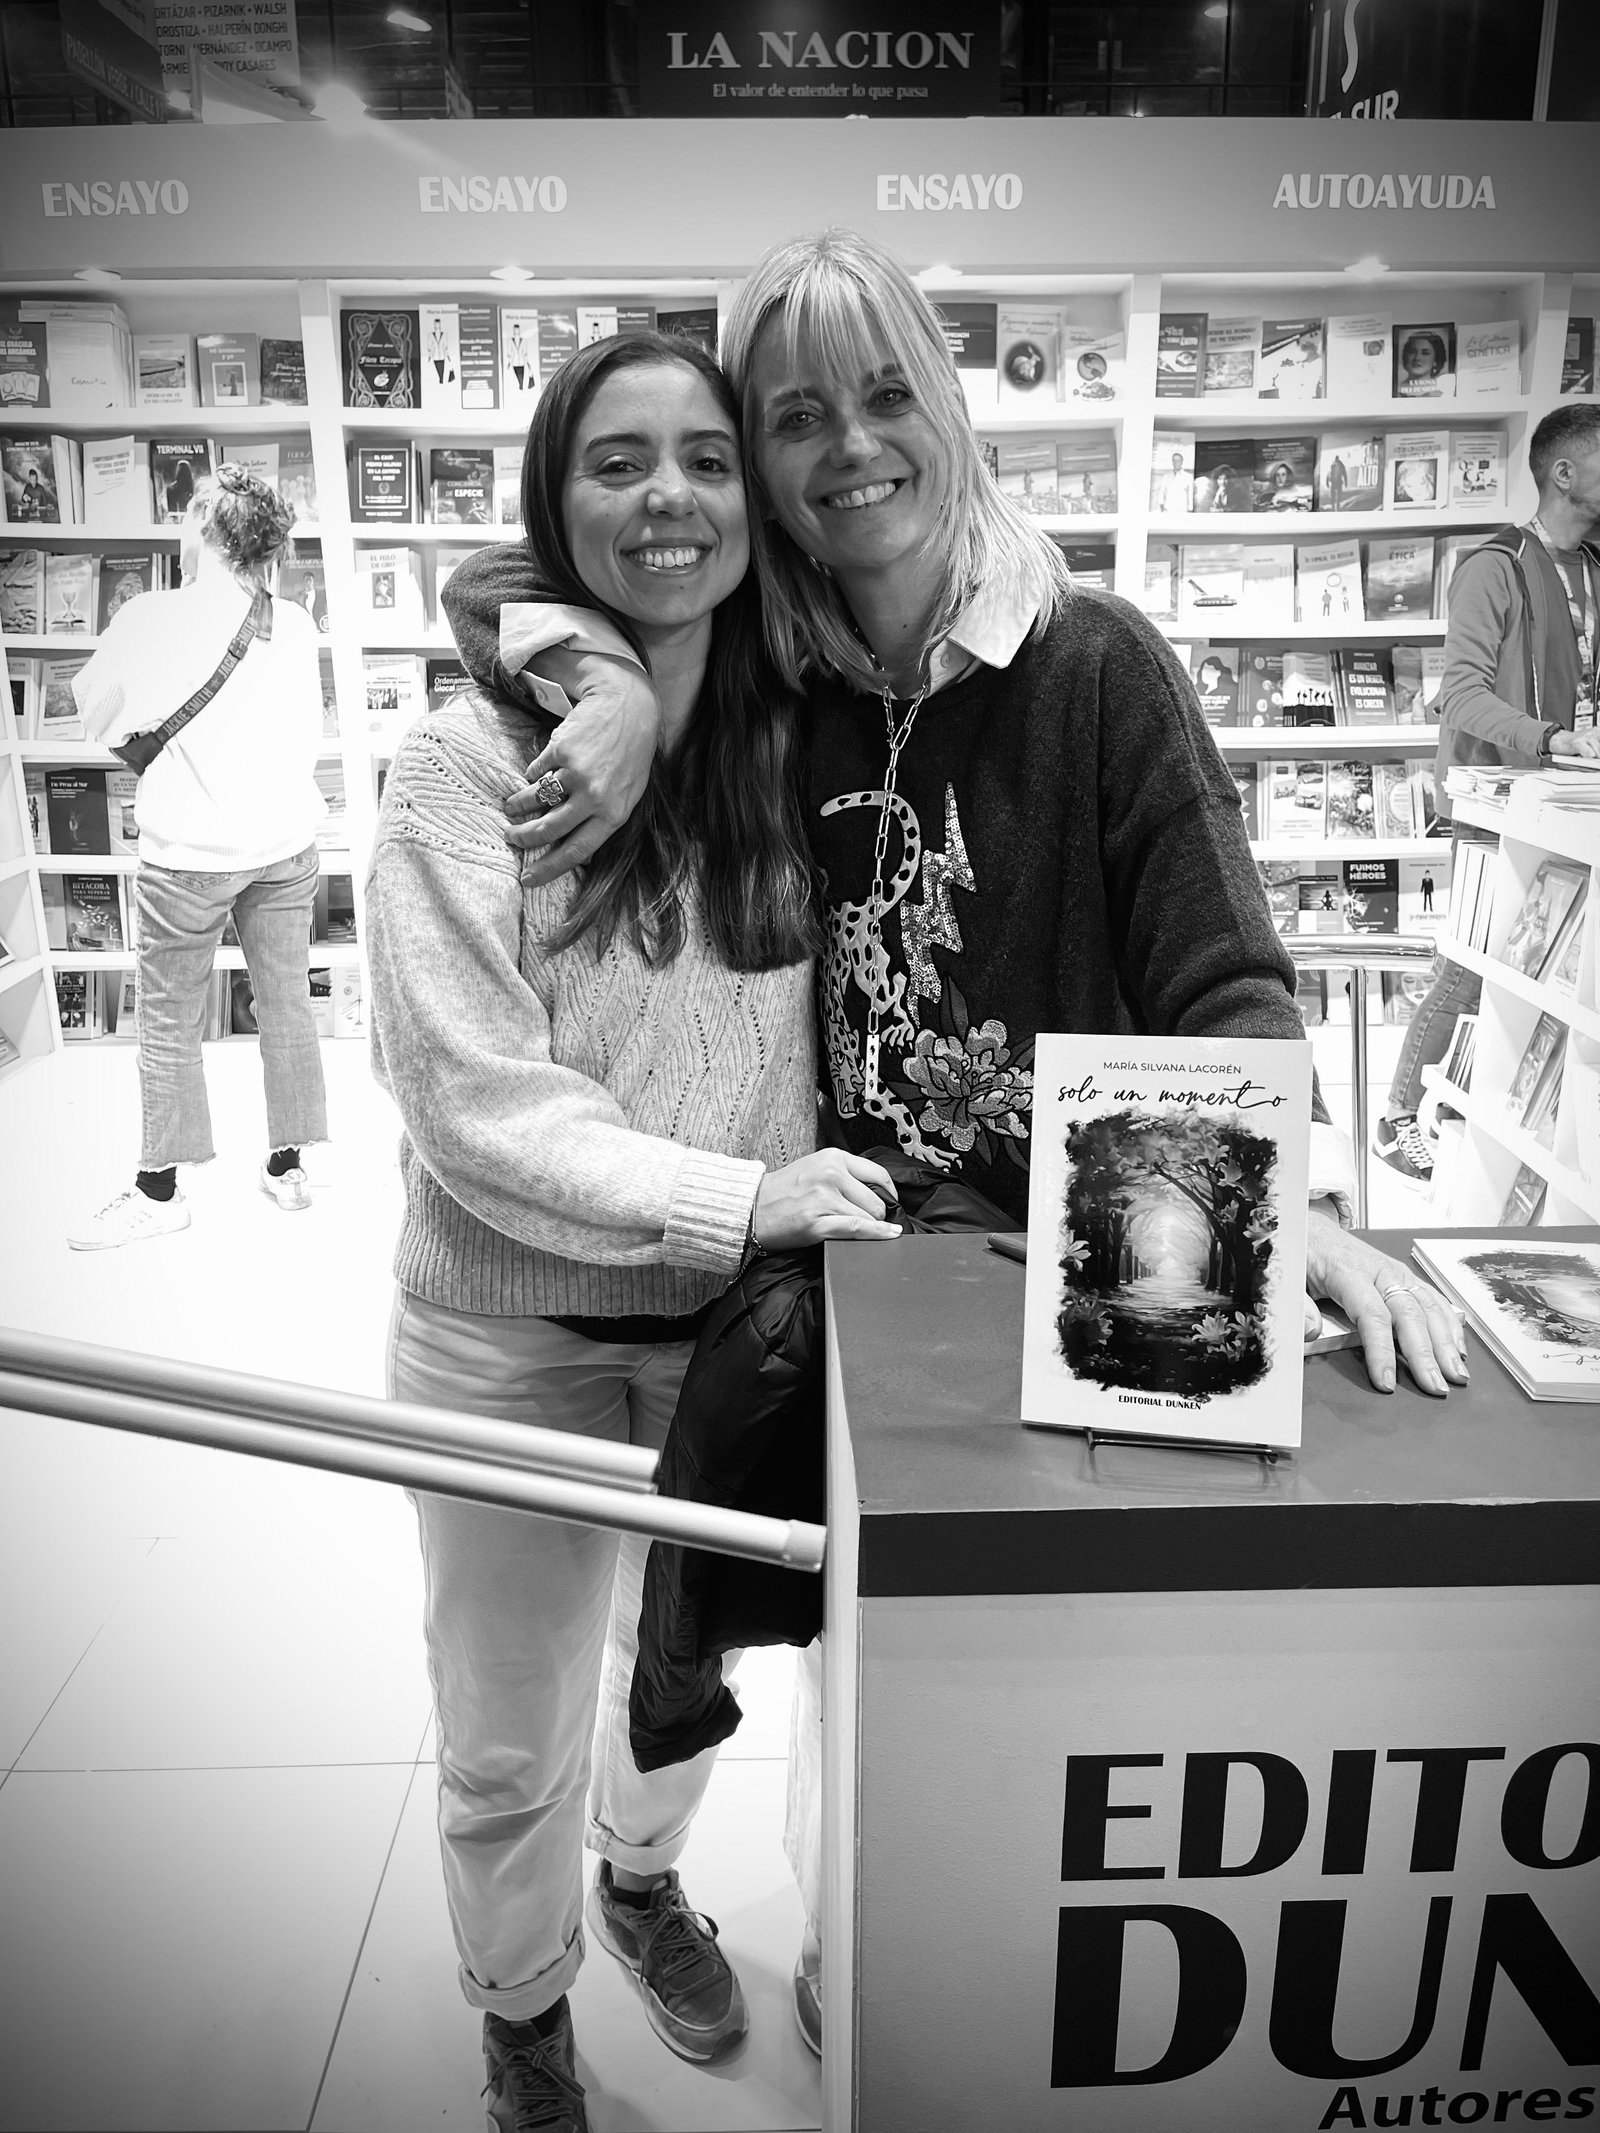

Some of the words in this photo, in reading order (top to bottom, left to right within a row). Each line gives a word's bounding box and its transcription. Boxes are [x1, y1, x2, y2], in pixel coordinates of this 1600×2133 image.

[204, 5, 246, 17] PIZARNIK
[253, 3, 287, 15] WALSH
[254, 22, 288, 34] DONGHI
[255, 40, 292, 53] OCAMPO
[666, 32, 741, 68] LA
[758, 31, 974, 69] NACION
[236, 60, 276, 72] CASARES
[712, 83, 727, 98] El
[729, 83, 765, 98] valor
[767, 83, 786, 98] de
[788, 83, 850, 98] entender
[852, 83, 865, 98] lo
[867, 86, 895, 101] que
[896, 86, 929, 101] pasa
[41, 179, 190, 217] ENSAYO
[418, 174, 568, 214] ENSAYO
[875, 172, 1024, 211] ENSAYO
[1272, 172, 1497, 210] AUTOAYUDA
[156, 444, 194, 455] TERMINAL
[162, 708, 191, 737] JACKIE
[184, 686, 214, 715] SMITH
[1349, 863, 1386, 872] FUIMOS
[1103, 1060, 1138, 1071] MARÍA
[1140, 1062, 1186, 1073] SILVANA
[1188, 1063, 1242, 1074] LACORÉN
[1058, 1075, 1103, 1103] solo
[1113, 1088, 1147, 1102] un
[1158, 1080, 1288, 1109] momento
[1118, 1395, 1163, 1407] EDITORIAL
[1165, 1399, 1202, 1410] DUNKEN
[1060, 1742, 1600, 1881] EDITO
[1317, 2086, 1597, 2131] Autores
